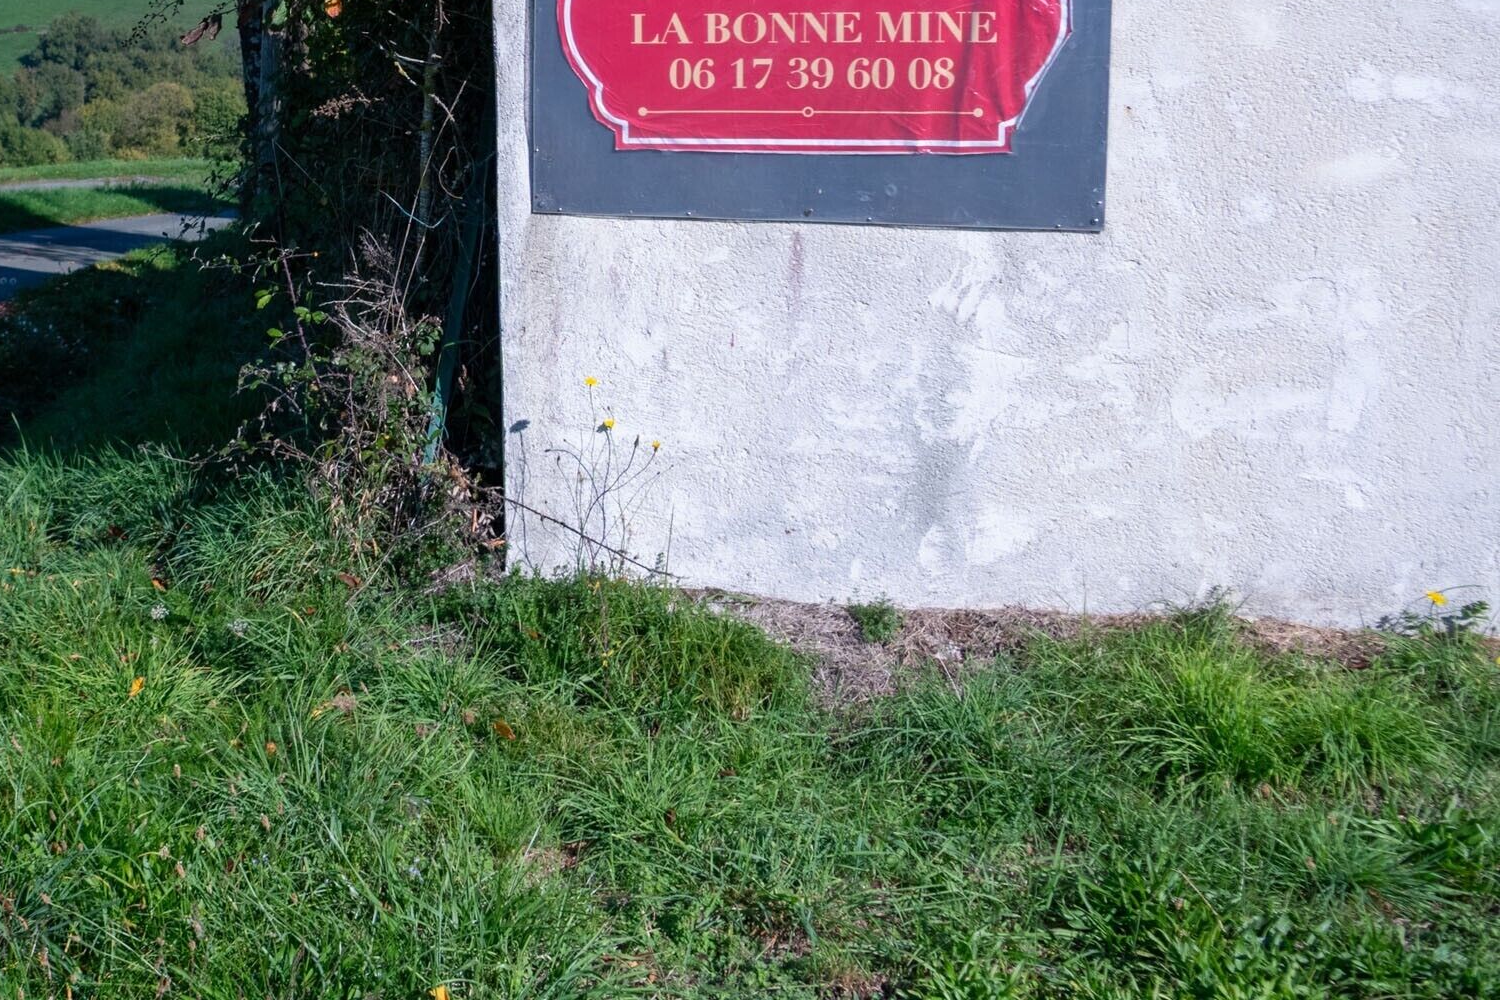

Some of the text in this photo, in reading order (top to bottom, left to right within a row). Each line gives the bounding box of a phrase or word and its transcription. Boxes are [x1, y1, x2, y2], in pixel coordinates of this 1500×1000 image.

[631, 12, 997, 44] LA BONNE MINE
[669, 57, 955, 89] 06 17 39 60 08
